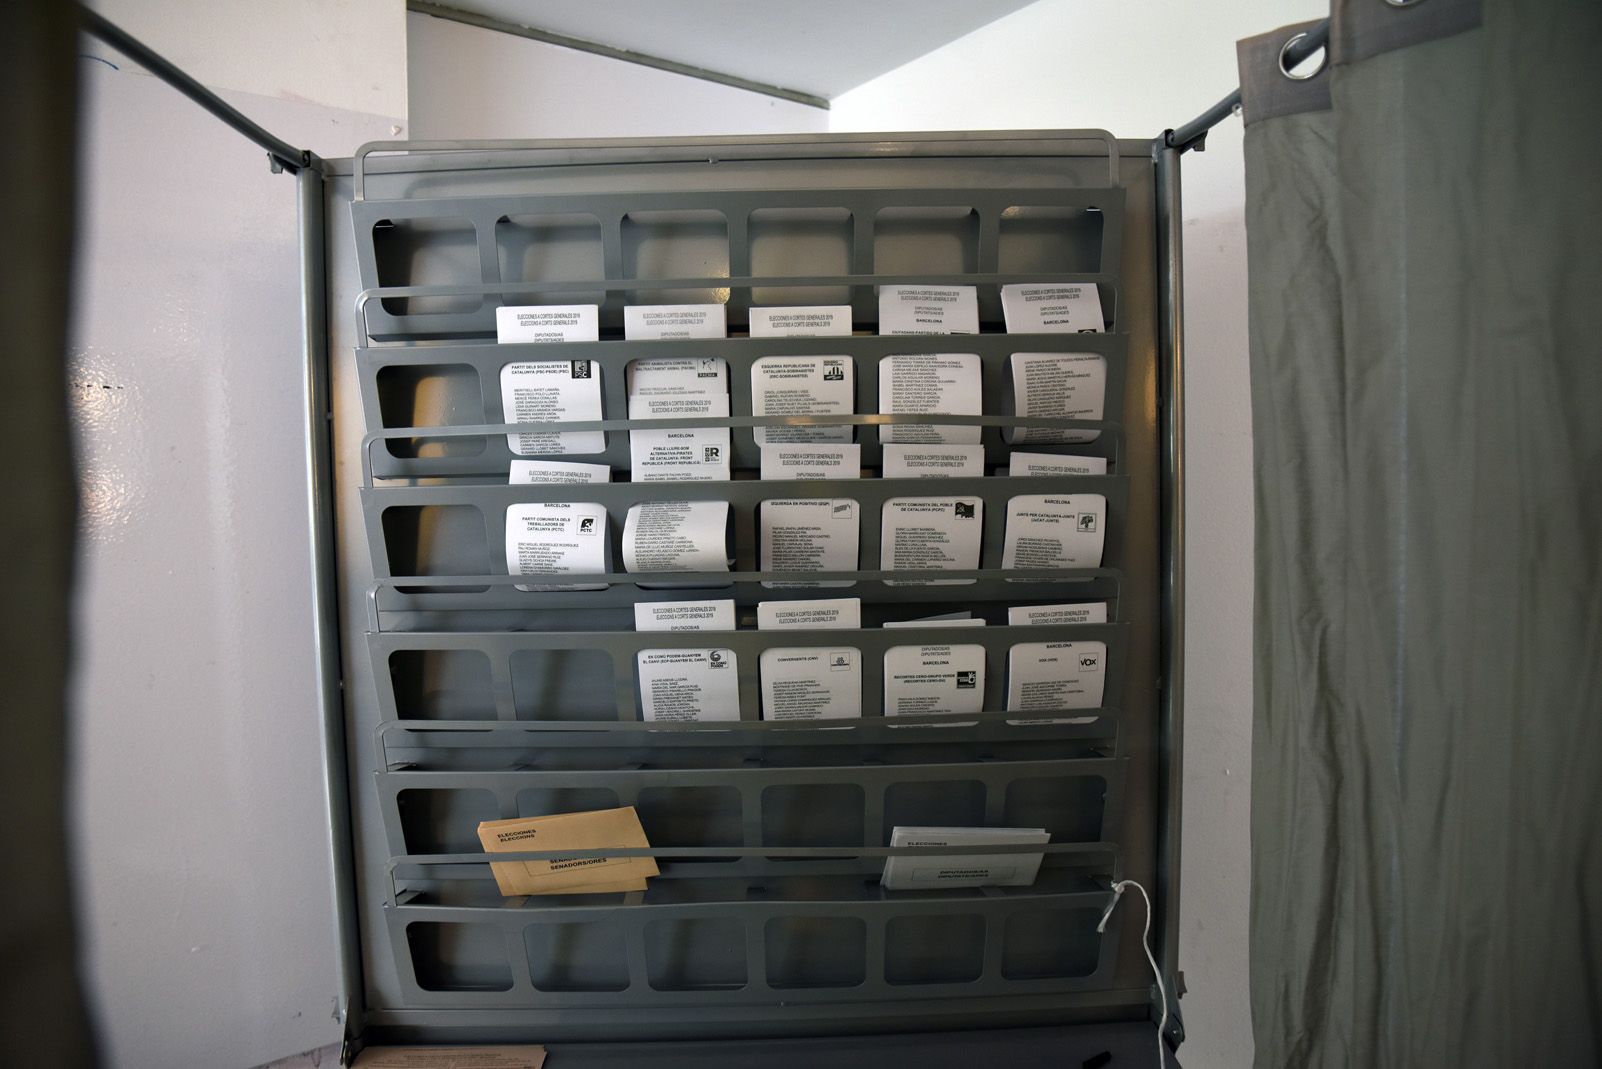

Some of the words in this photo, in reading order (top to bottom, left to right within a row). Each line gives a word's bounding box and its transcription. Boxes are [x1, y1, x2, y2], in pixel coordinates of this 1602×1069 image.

[710, 447, 720, 457] R
[1081, 658, 1096, 666] VOX
[497, 828, 537, 838] ELECCIONES
[500, 834, 535, 843] ELECCIONS
[550, 857, 607, 870] SENADORS/ORES
